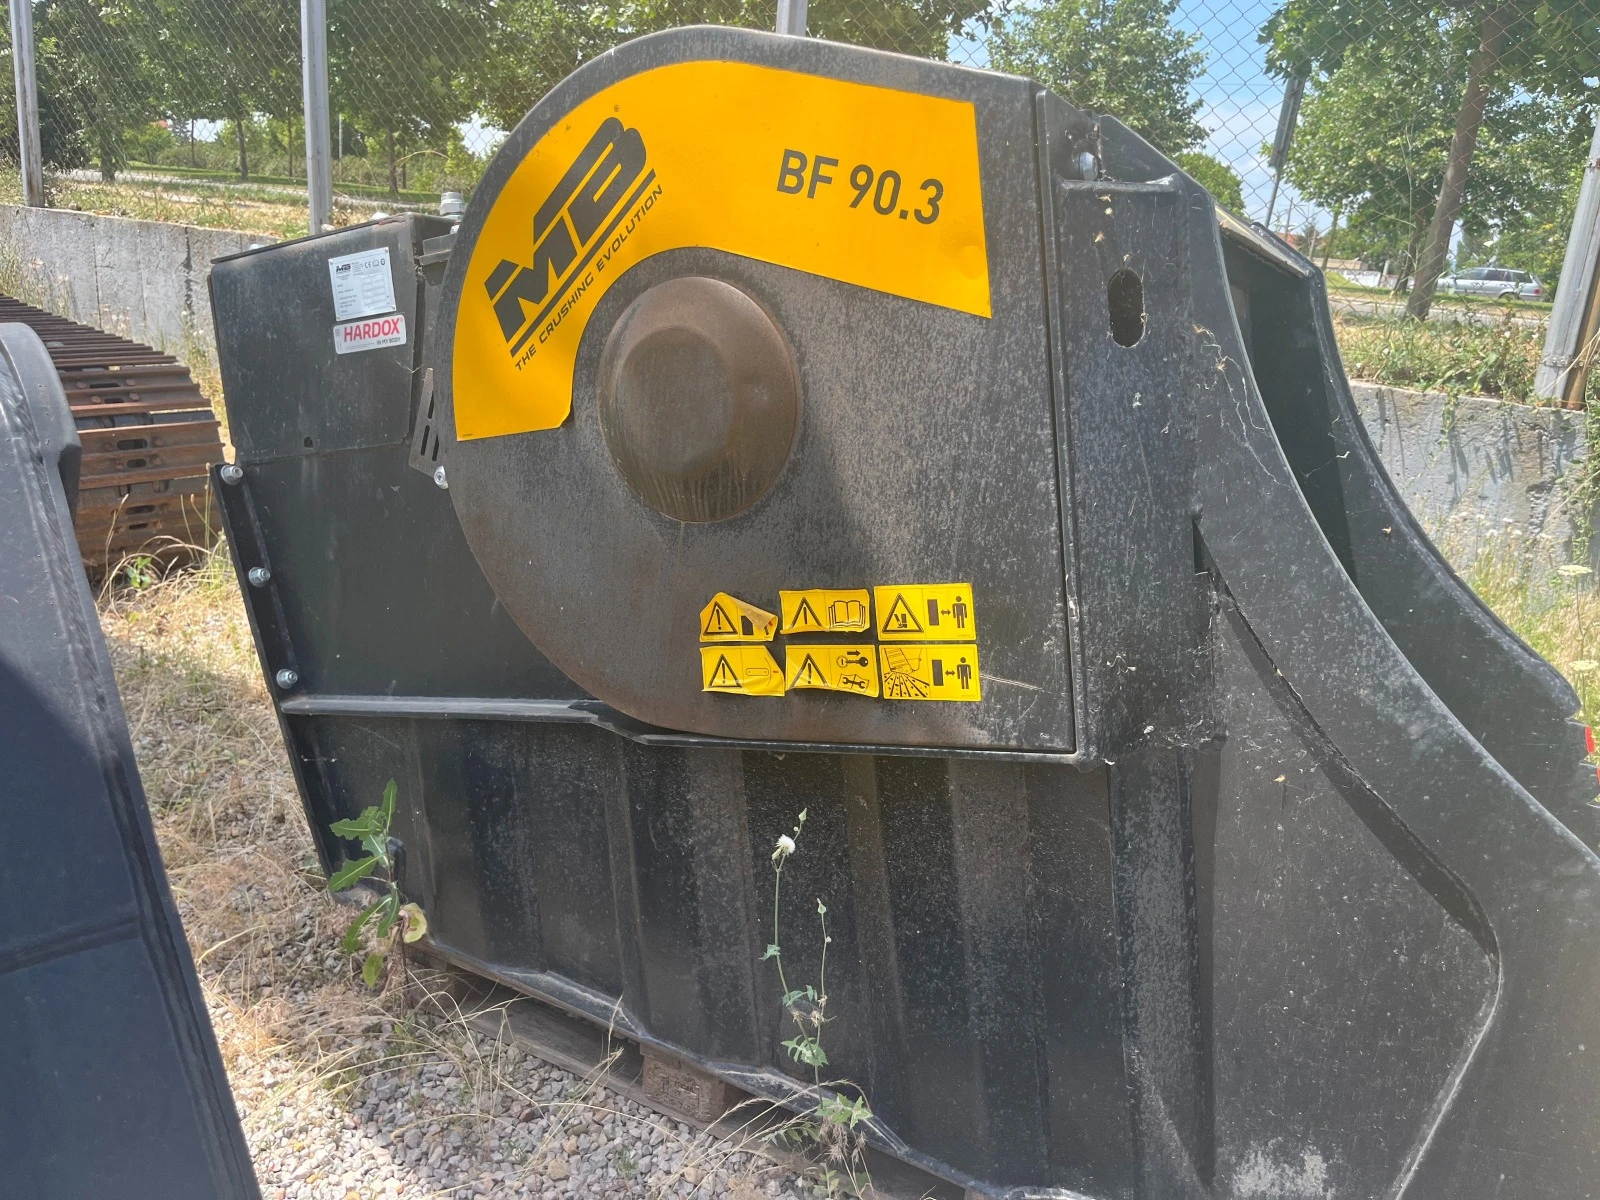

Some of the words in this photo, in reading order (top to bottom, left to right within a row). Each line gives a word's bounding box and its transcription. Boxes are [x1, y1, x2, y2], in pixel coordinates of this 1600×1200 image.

[484, 116, 647, 344] MB
[777, 148, 839, 200] BF
[848, 164, 944, 225] 90.3
[344, 318, 400, 342] HARDOX
[515, 344, 536, 371] THE
[538, 272, 594, 344] CRUSHING
[596, 184, 663, 272] EVOLUTION
